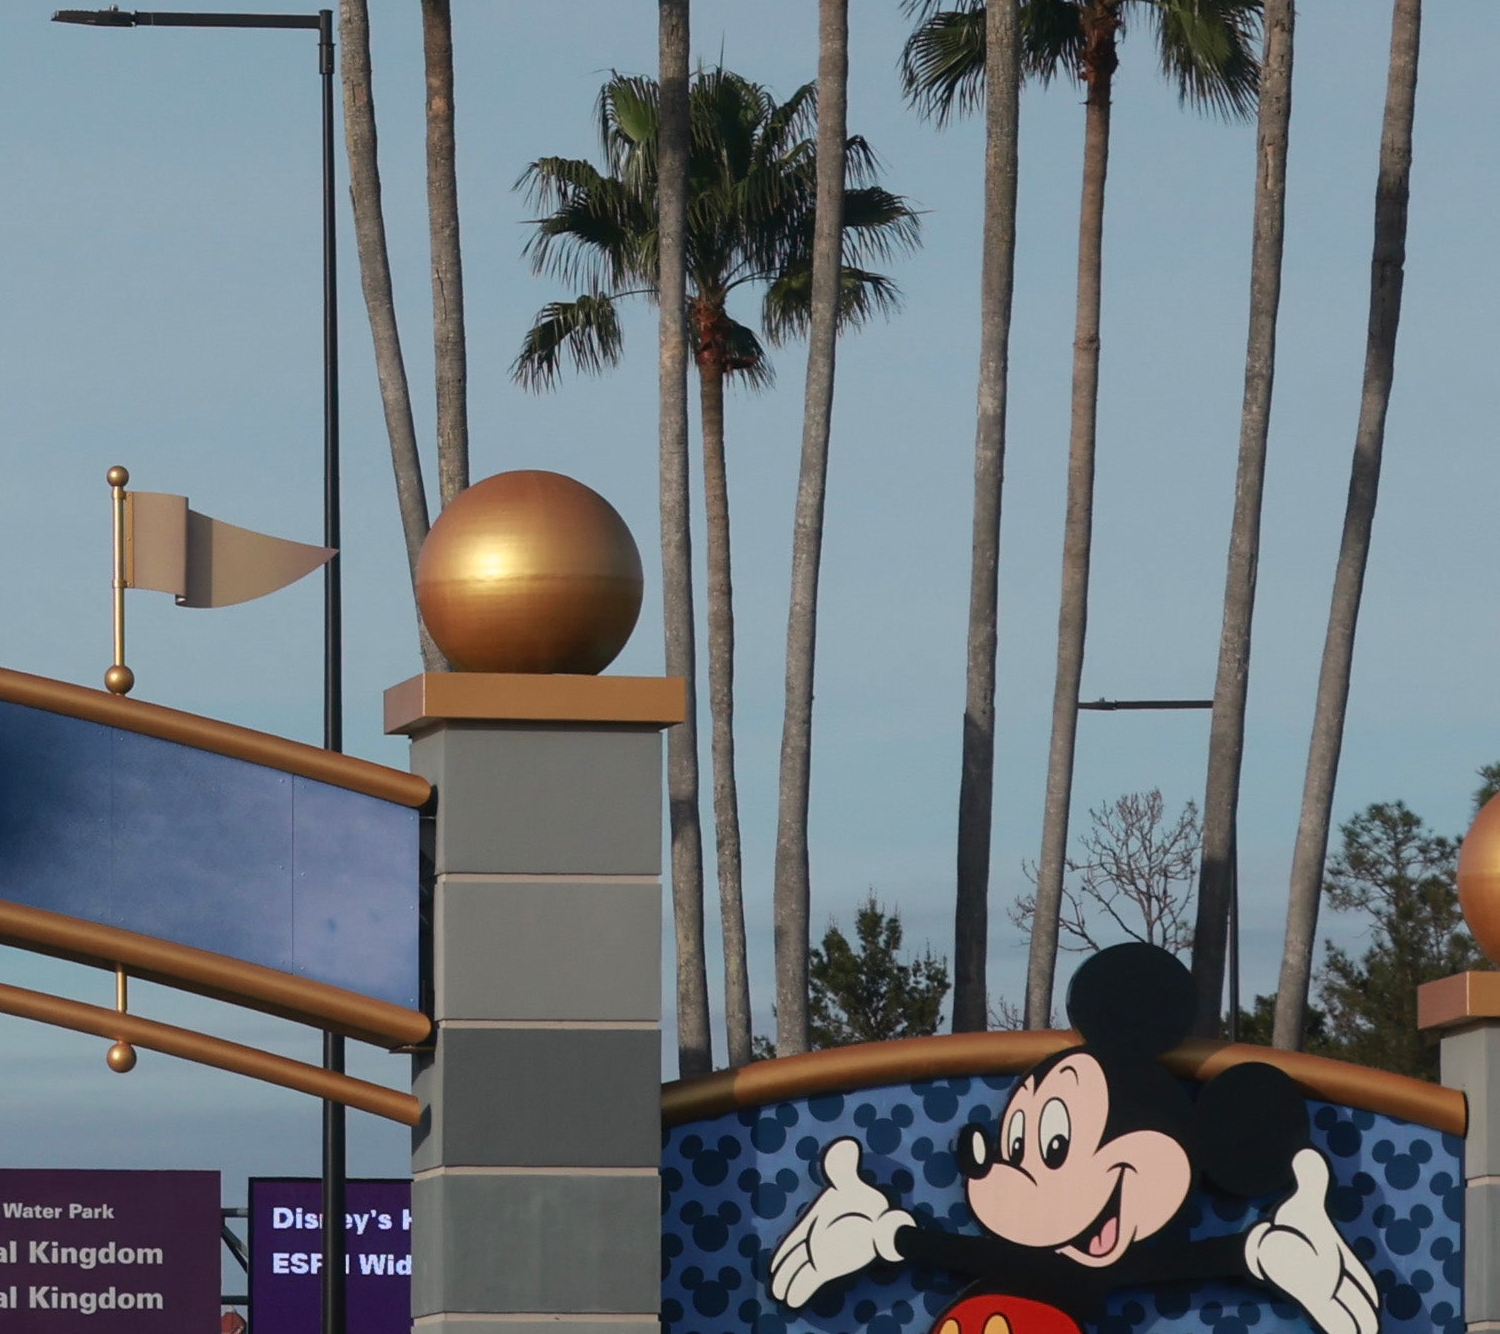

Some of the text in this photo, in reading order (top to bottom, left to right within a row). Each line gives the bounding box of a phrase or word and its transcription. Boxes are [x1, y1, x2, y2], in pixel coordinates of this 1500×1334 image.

[3, 1203, 62, 1219] Water
[69, 1203, 114, 1220] Park
[273, 1207, 392, 1235] Disey's
[29, 1241, 163, 1269] Kingdom
[273, 1253, 349, 1274] ESP
[29, 1286, 163, 1315] Kingdom
